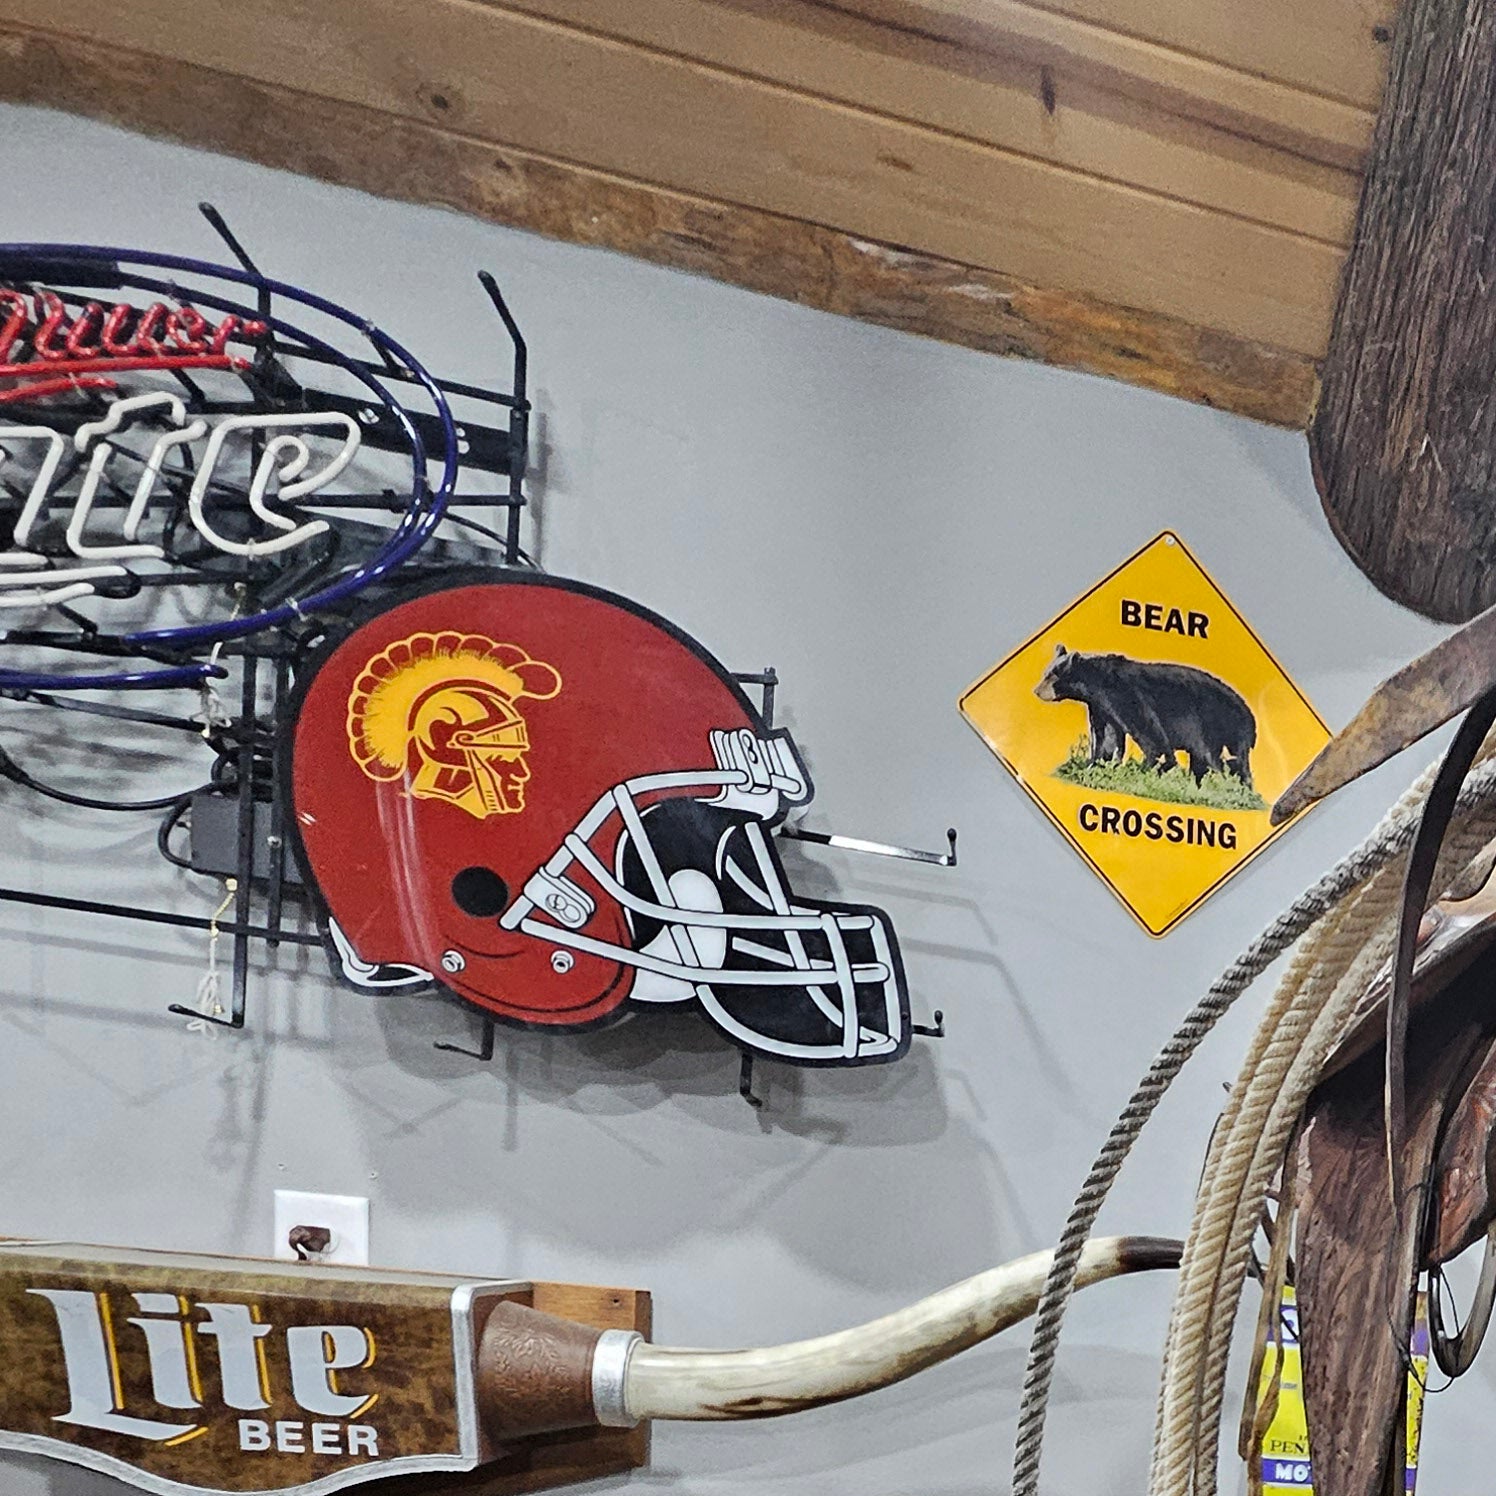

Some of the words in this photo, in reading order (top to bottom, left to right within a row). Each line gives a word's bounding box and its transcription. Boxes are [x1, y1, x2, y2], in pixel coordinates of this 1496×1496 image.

[1120, 599, 1210, 639] BEAR
[1079, 803, 1238, 850] CROSSING
[26, 1288, 379, 1446] Lite
[238, 1421, 379, 1457] BEER
[1275, 1462, 1311, 1482] MO
